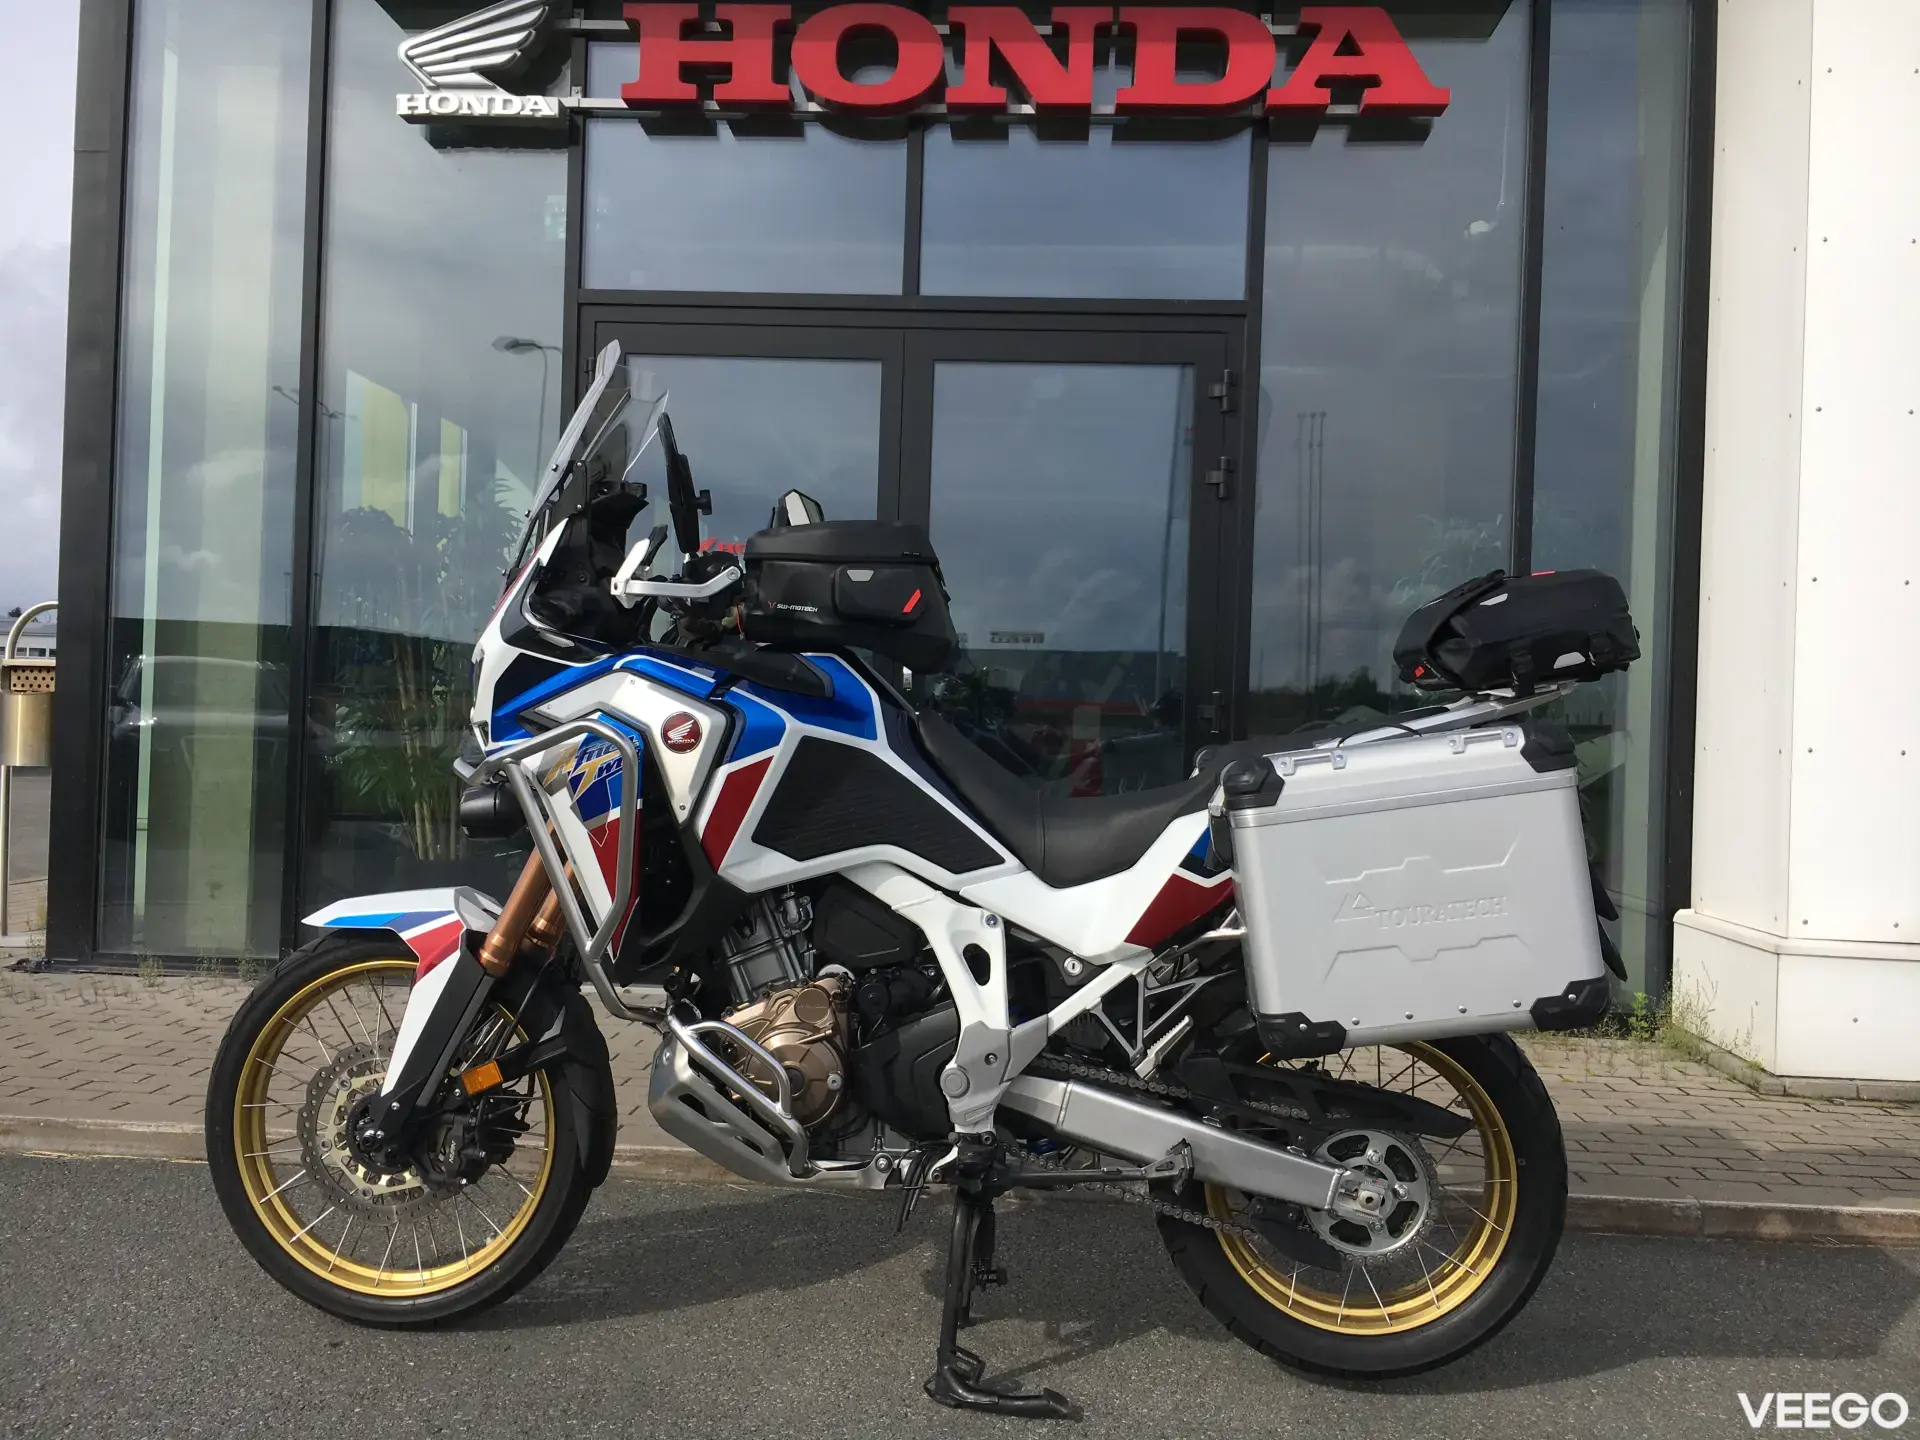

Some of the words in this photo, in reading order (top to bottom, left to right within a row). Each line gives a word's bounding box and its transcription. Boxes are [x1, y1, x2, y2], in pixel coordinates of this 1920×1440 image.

[621, 3, 1450, 114] HONDA
[396, 93, 555, 115] HONDA
[776, 603, 818, 613] SW-MOTECH
[1373, 897, 1508, 929] TOURATECH
